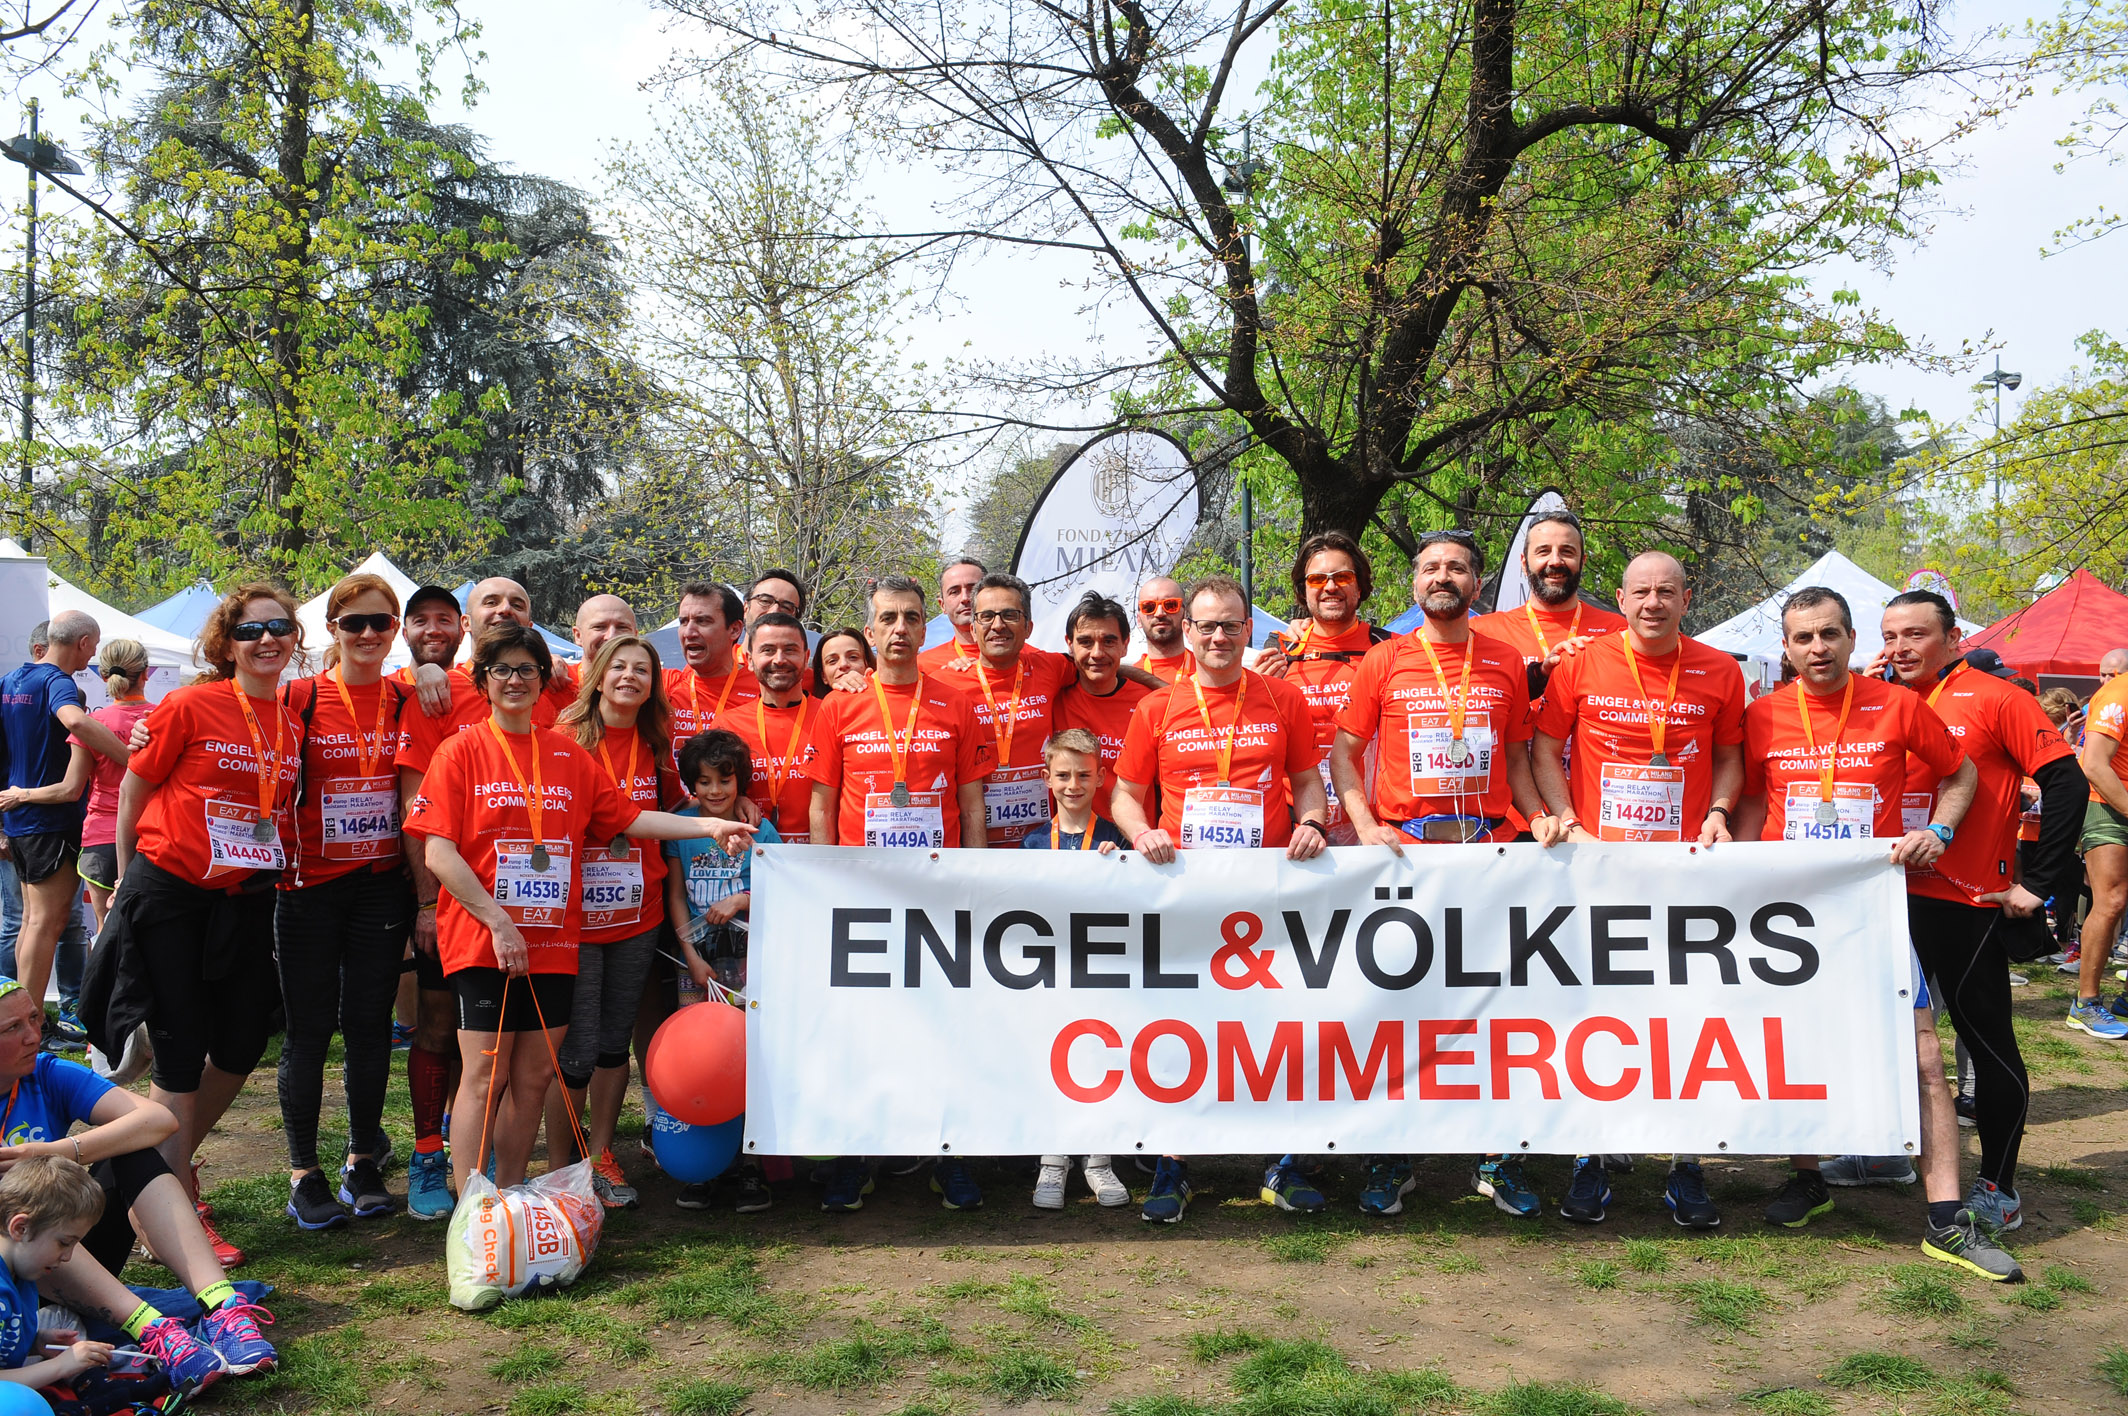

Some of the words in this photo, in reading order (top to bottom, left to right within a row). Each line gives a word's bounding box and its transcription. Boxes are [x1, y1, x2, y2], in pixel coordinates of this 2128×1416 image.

[1057, 528, 1161, 543] FONDAZIONE
[1056, 547, 1161, 573] MILAN
[1406, 699, 1494, 711] COMMECIAL
[1587, 695, 1705, 715] ENGEL&VÖLKERS
[844, 728, 951, 743] ENGELVÖLKERS
[1166, 723, 1278, 741] ENGEL&VÖLKERS
[1177, 736, 1268, 752] COMMERCIAL
[1767, 742, 1885, 758] ENGEL&VÖLKERS
[1780, 757, 1873, 770] COMMERCIAL
[1615, 768, 1633, 776] EA7
[1439, 779, 1462, 789] EA7
[220, 807, 240, 816] EA7
[996, 802, 1036, 820] 1443C
[1616, 804, 1665, 822] 1442D
[340, 815, 388, 834] 1464A
[1005, 826, 1027, 837] EA7
[1804, 822, 1851, 839] 1451A
[881, 832, 929, 847] 1449A
[1199, 826, 1245, 844] 1453A
[1625, 830, 1653, 842] EA7
[224, 843, 272, 862] 1444D
[352, 841, 379, 854] EA7
[509, 844, 527, 852] EA7
[693, 869, 717, 877] LOVE
[720, 869, 737, 877] MY
[515, 881, 560, 898] 1453B
[523, 908, 552, 920] EA7
[587, 911, 614, 923] EA7
[831, 887, 1819, 990] ENGEL&VÖLKERS
[1050, 1017, 1827, 1103] COMMERCIAL
[480, 1197, 494, 1223] Bag
[532, 1206, 559, 1255] 1453B
[483, 1228, 500, 1283] Check
